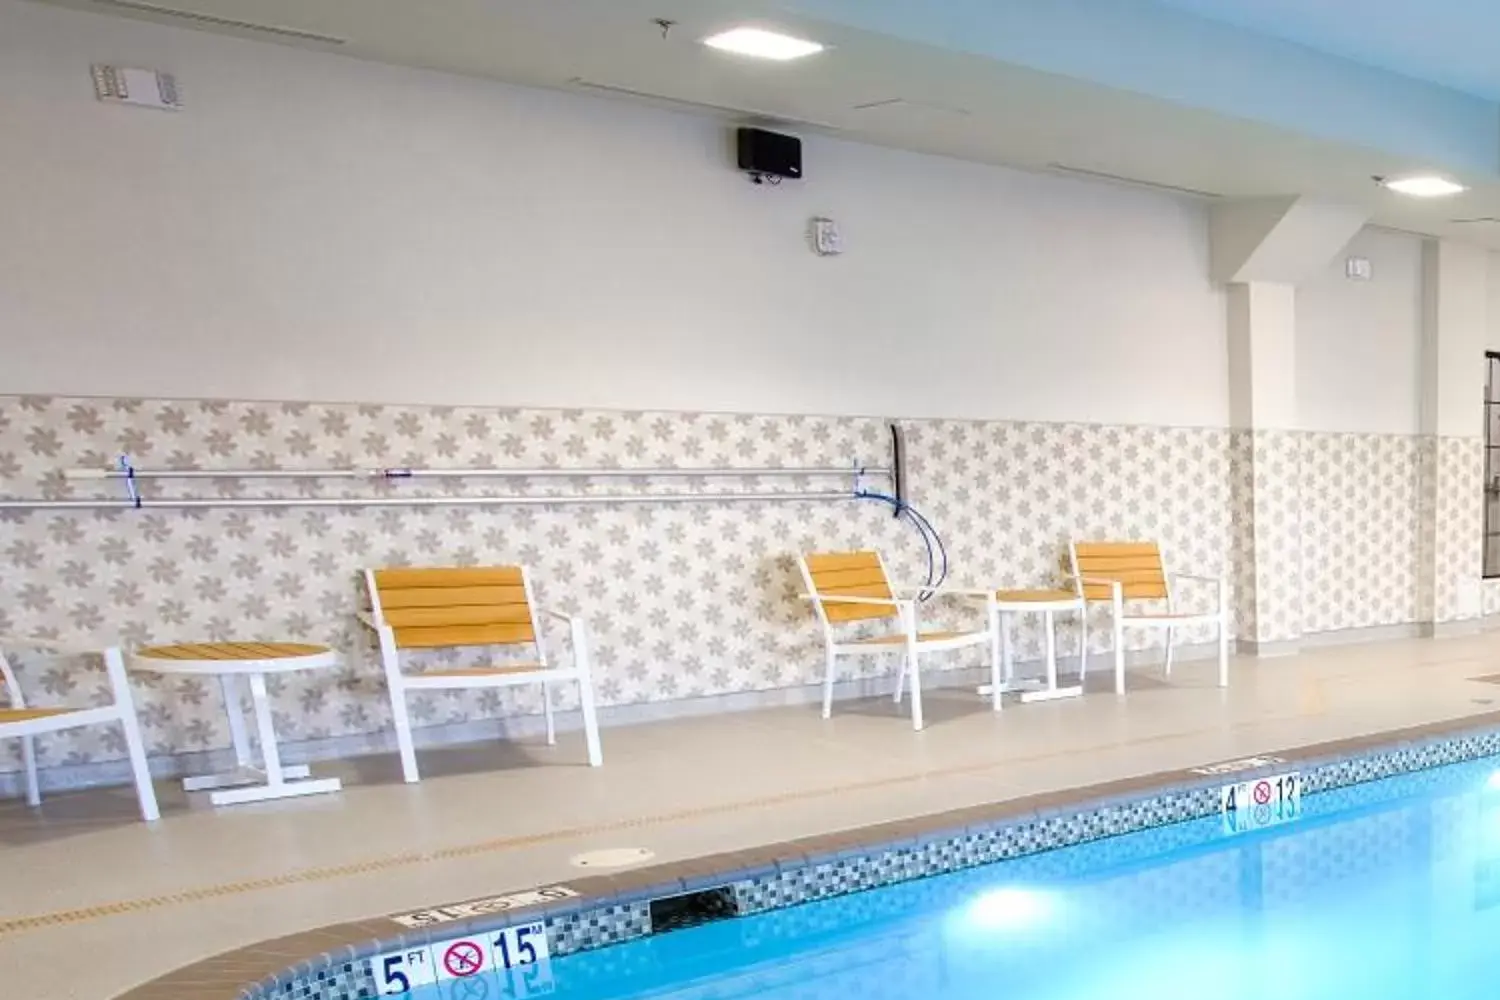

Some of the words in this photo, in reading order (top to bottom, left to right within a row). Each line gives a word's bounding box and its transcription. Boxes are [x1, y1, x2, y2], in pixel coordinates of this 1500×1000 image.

[1226, 786, 1237, 811] 4
[383, 955, 411, 995] 5
[407, 950, 426, 965] FT
